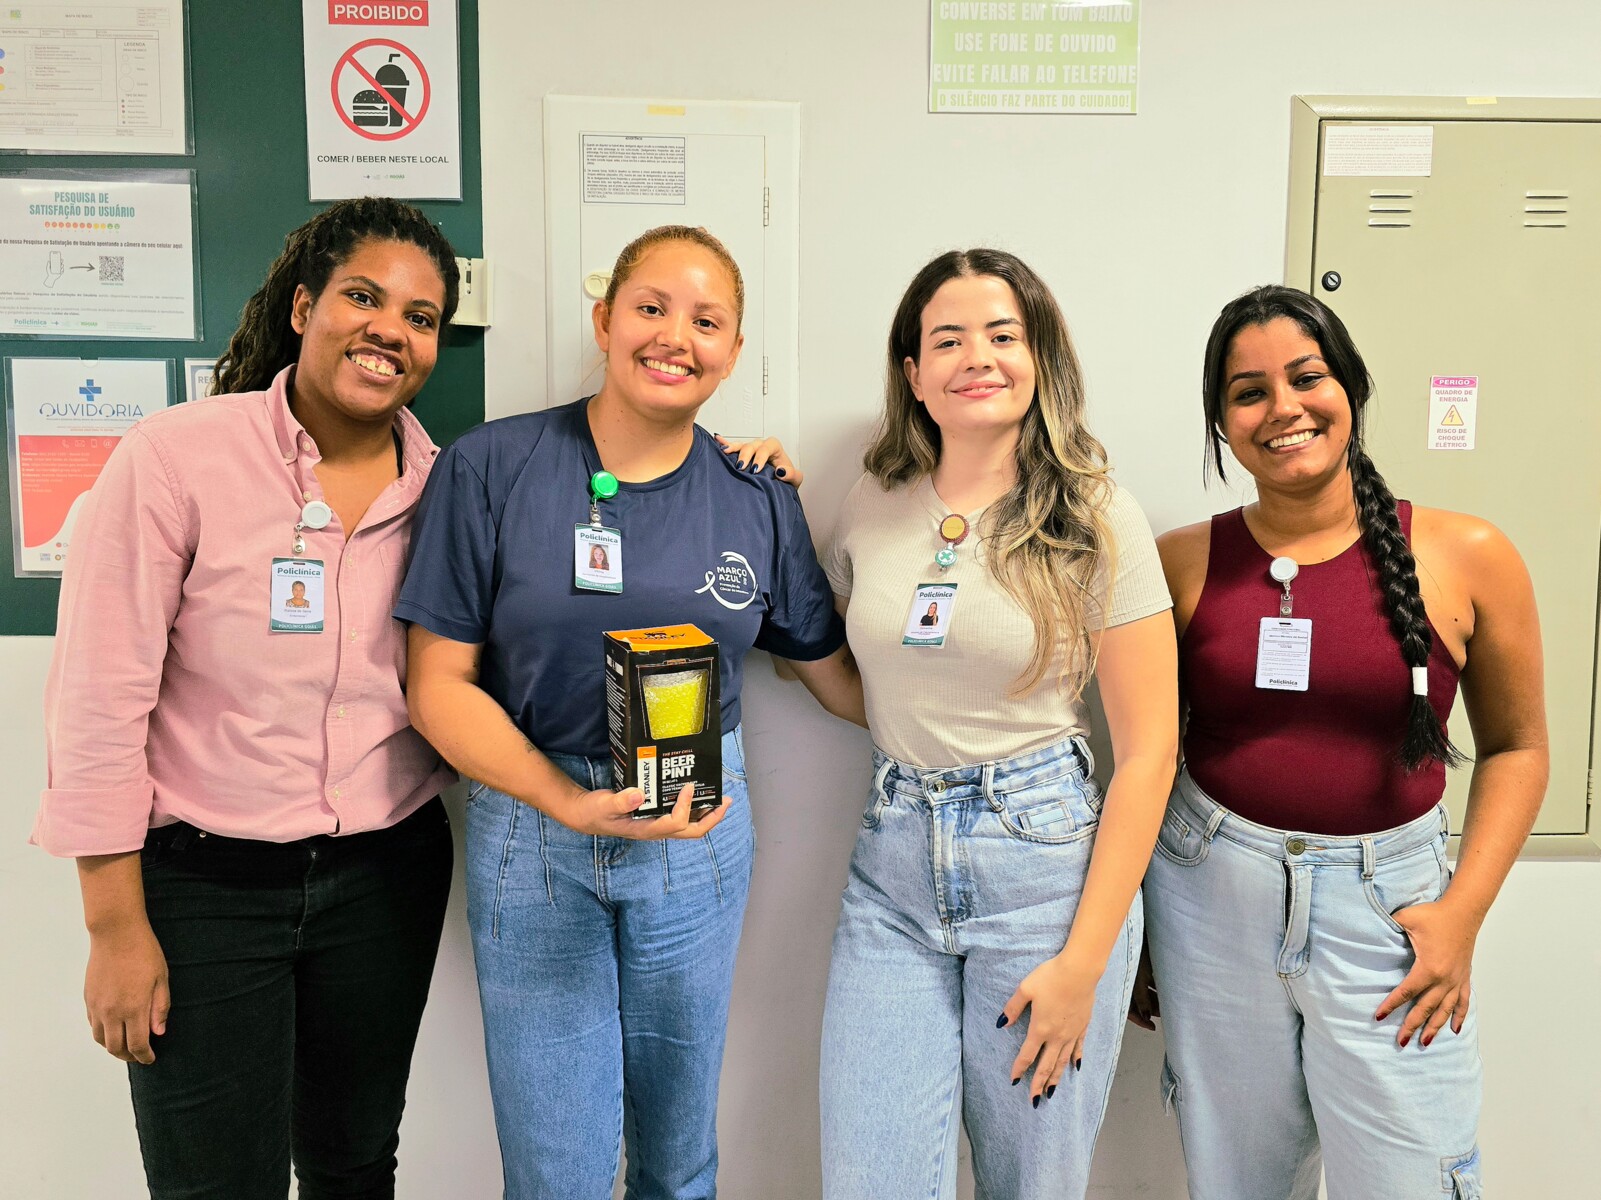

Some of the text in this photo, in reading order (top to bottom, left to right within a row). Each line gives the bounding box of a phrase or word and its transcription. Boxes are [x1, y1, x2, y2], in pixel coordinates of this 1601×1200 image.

[334, 4, 423, 21] PROIBIDO
[939, 2, 1133, 22] CONVERSE EM TOM BAIXO
[954, 33, 1116, 53] USE FONE DE OUVIDO
[933, 64, 1136, 84] EVITE FALAR AO TELEFONE
[939, 91, 1129, 108] O SILÊNCIO FAZ PARTE DO CUIDADO!
[317, 155, 449, 164] COMER / BEBER NESTE LOCAL
[54, 191, 109, 204] PESQUISA DE
[29, 204, 135, 219] SATISFAÇÃO DO USUÁRIO
[39, 402, 144, 418] OUVIDORIA
[580, 532, 619, 544] Policlínica
[277, 567, 321, 576] Policlínica
[716, 566, 747, 578] MARÇO
[718, 574, 741, 584] AZUL
[1269, 678, 1298, 686] Policlínica
[662, 754, 695, 769] BEER
[643, 761, 651, 794] STANLEY
[662, 765, 695, 780] PINT
